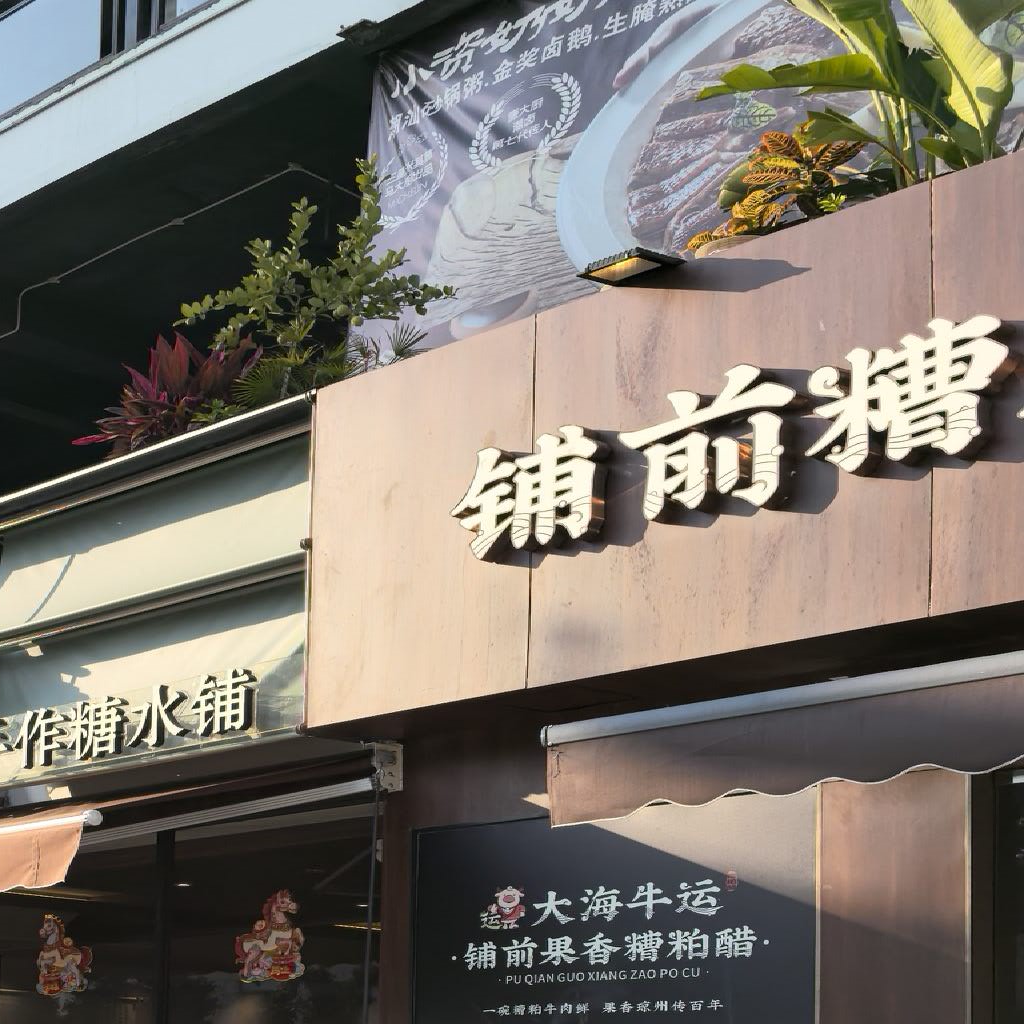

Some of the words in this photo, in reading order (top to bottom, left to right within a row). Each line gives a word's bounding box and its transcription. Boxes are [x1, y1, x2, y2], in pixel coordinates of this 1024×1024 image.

[450, 314, 1024, 560] 铺前糟
[531, 878, 726, 929] 大海牛运
[505, 974, 521, 986] PU
[524, 973, 555, 986] QIAN
[556, 971, 585, 983] GUO
[587, 970, 628, 981] XIANG
[630, 969, 657, 980] ZAO
[659, 968, 679, 979] PO
[681, 967, 701, 979] CU
